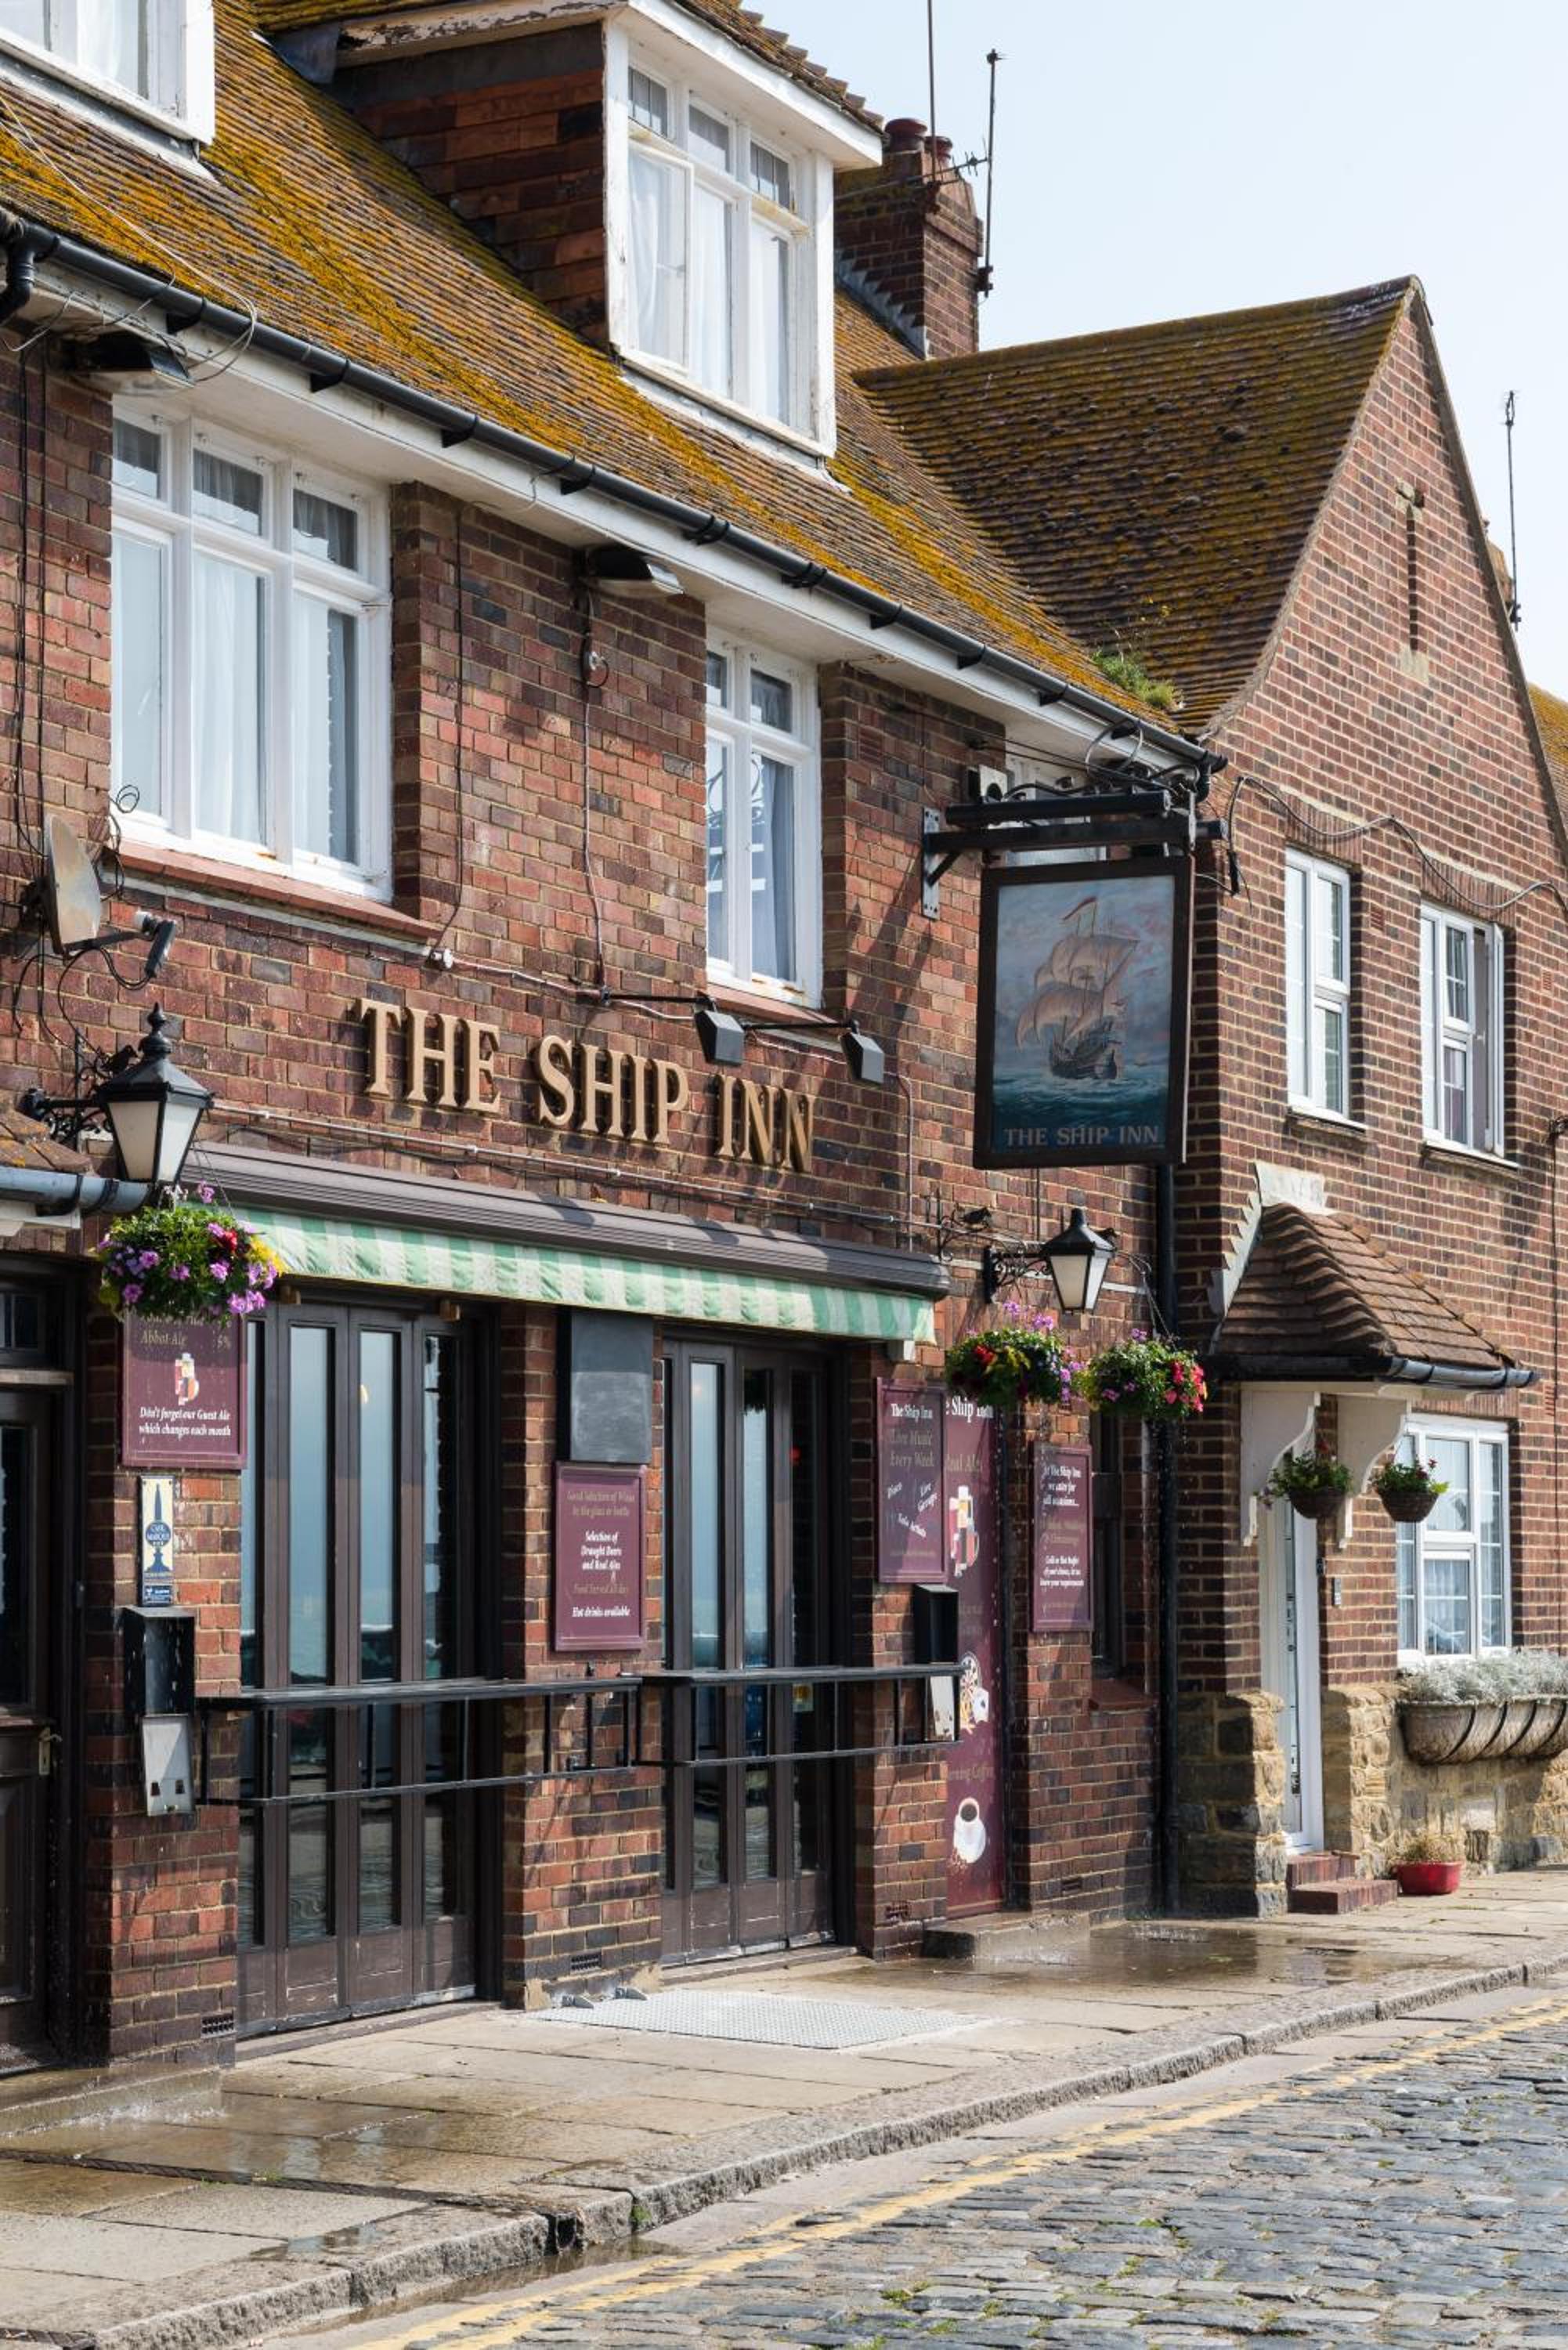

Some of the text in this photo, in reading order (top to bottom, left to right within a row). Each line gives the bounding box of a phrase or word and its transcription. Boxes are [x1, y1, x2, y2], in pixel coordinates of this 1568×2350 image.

[360, 998, 816, 1172] THE SHIP INN
[1004, 1125, 1158, 1147] THE SHIP INN
[140, 1406, 230, 1422] Don't forget our Guest Ale
[891, 1403, 903, 1417] The
[904, 1403, 919, 1423] Ship
[920, 1405, 933, 1419] Inn
[952, 1395, 974, 1423] Ship
[139, 1422, 231, 1441] which changes each month
[1060, 1466, 1071, 1480] Ship
[1071, 1466, 1082, 1478] Inn
[1067, 1481, 1077, 1495] for
[585, 1530, 619, 1545] Selection of
[580, 1544, 623, 1559] Draught Beers
[582, 1559, 621, 1571] and Real Ales
[572, 1605, 631, 1618] Hot drinks available
